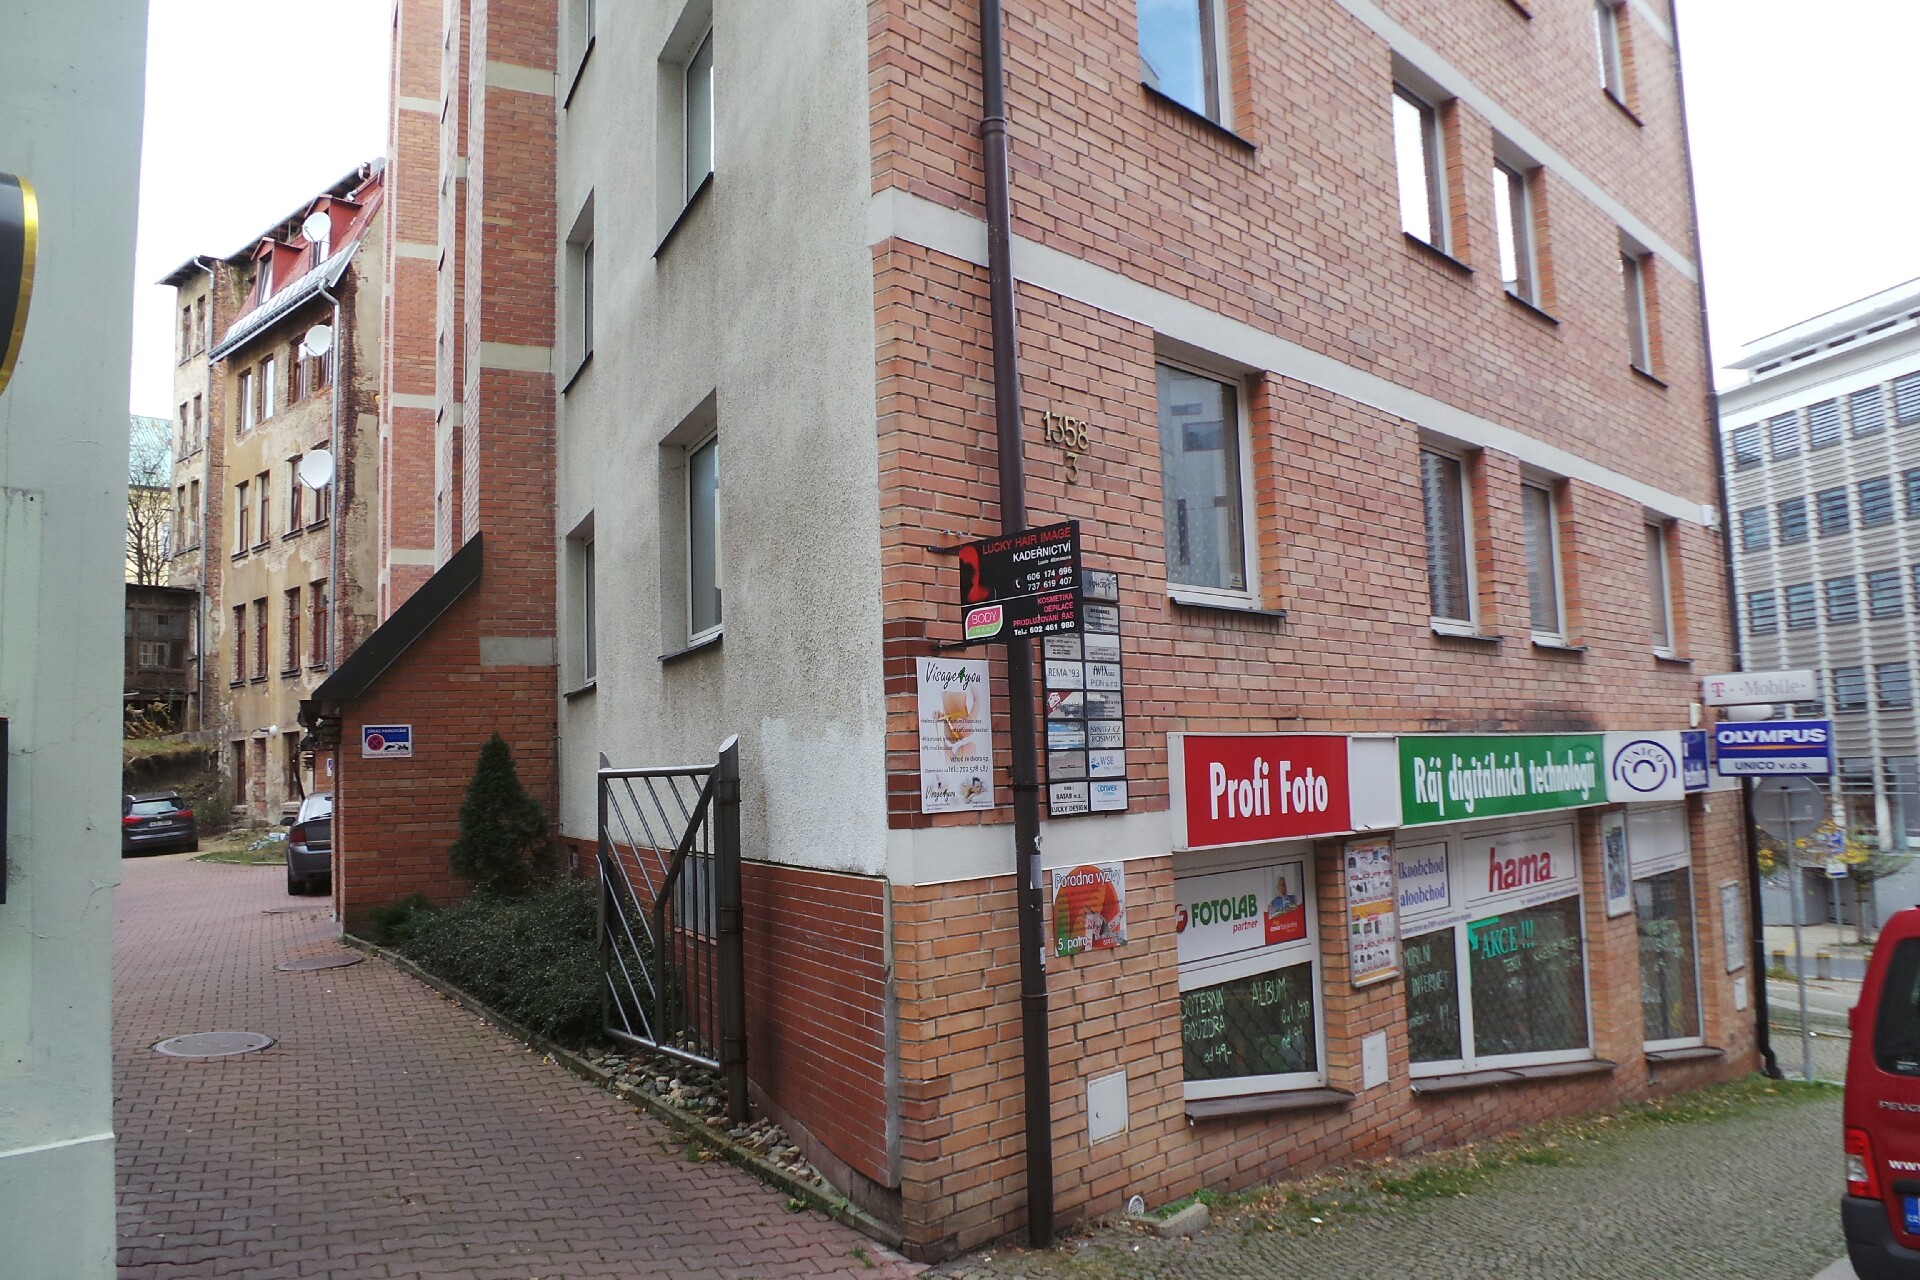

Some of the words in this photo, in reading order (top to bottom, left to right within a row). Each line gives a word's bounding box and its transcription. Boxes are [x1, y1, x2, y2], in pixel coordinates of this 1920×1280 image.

[1043, 411, 1089, 450] 1358
[1066, 451, 1079, 482] 3
[982, 540, 1013, 555] LUCKY
[1015, 534, 1038, 548] HAIR
[1040, 527, 1071, 543] IMAGE
[1013, 540, 1071, 563] KADEŘNICTVÍ
[1027, 572, 1041, 581] 606
[1044, 569, 1056, 578] 174
[1058, 566, 1073, 576] 696
[1027, 582, 1041, 591] 737
[1043, 579, 1056, 588] 619
[1059, 576, 1073, 586] 407
[1037, 592, 1074, 605] KOSMETIKA
[1044, 602, 1074, 613] DEPILACE
[971, 611, 997, 625] BODY
[1013, 613, 1059, 627] PRODLUŽOVÁNÍ
[1061, 611, 1074, 619] ŘAS
[1029, 625, 1043, 634] 602
[1045, 623, 1058, 632] 461
[1061, 621, 1075, 629] 980
[1048, 668, 1068, 677] REMA
[1717, 728, 1827, 744] OLYMPUS
[1623, 747, 1664, 764] UNICO
[1735, 761, 1776, 771] UNICO
[1779, 762, 1812, 770] v.o.s.
[1209, 756, 1270, 820] Profi
[1279, 760, 1328, 812] Foto
[1414, 756, 1445, 816] Ráj
[1448, 751, 1526, 813] digitálních
[1529, 749, 1596, 800] technologií
[1069, 804, 1088, 812] DESIGN
[1489, 847, 1551, 892] hama
[1054, 871, 1094, 889] Poradna
[1400, 882, 1446, 907] aloobchod
[1191, 894, 1258, 928] FOTOLAB
[1233, 920, 1258, 934] partner
[1058, 937, 1065, 951] 5.
[1067, 935, 1088, 953] patro
[1481, 926, 1519, 959] AKCE
[1521, 920, 1536, 948] !!!
[1252, 977, 1287, 1007] ALBUM
[1184, 1014, 1226, 1042] POUZDRA
